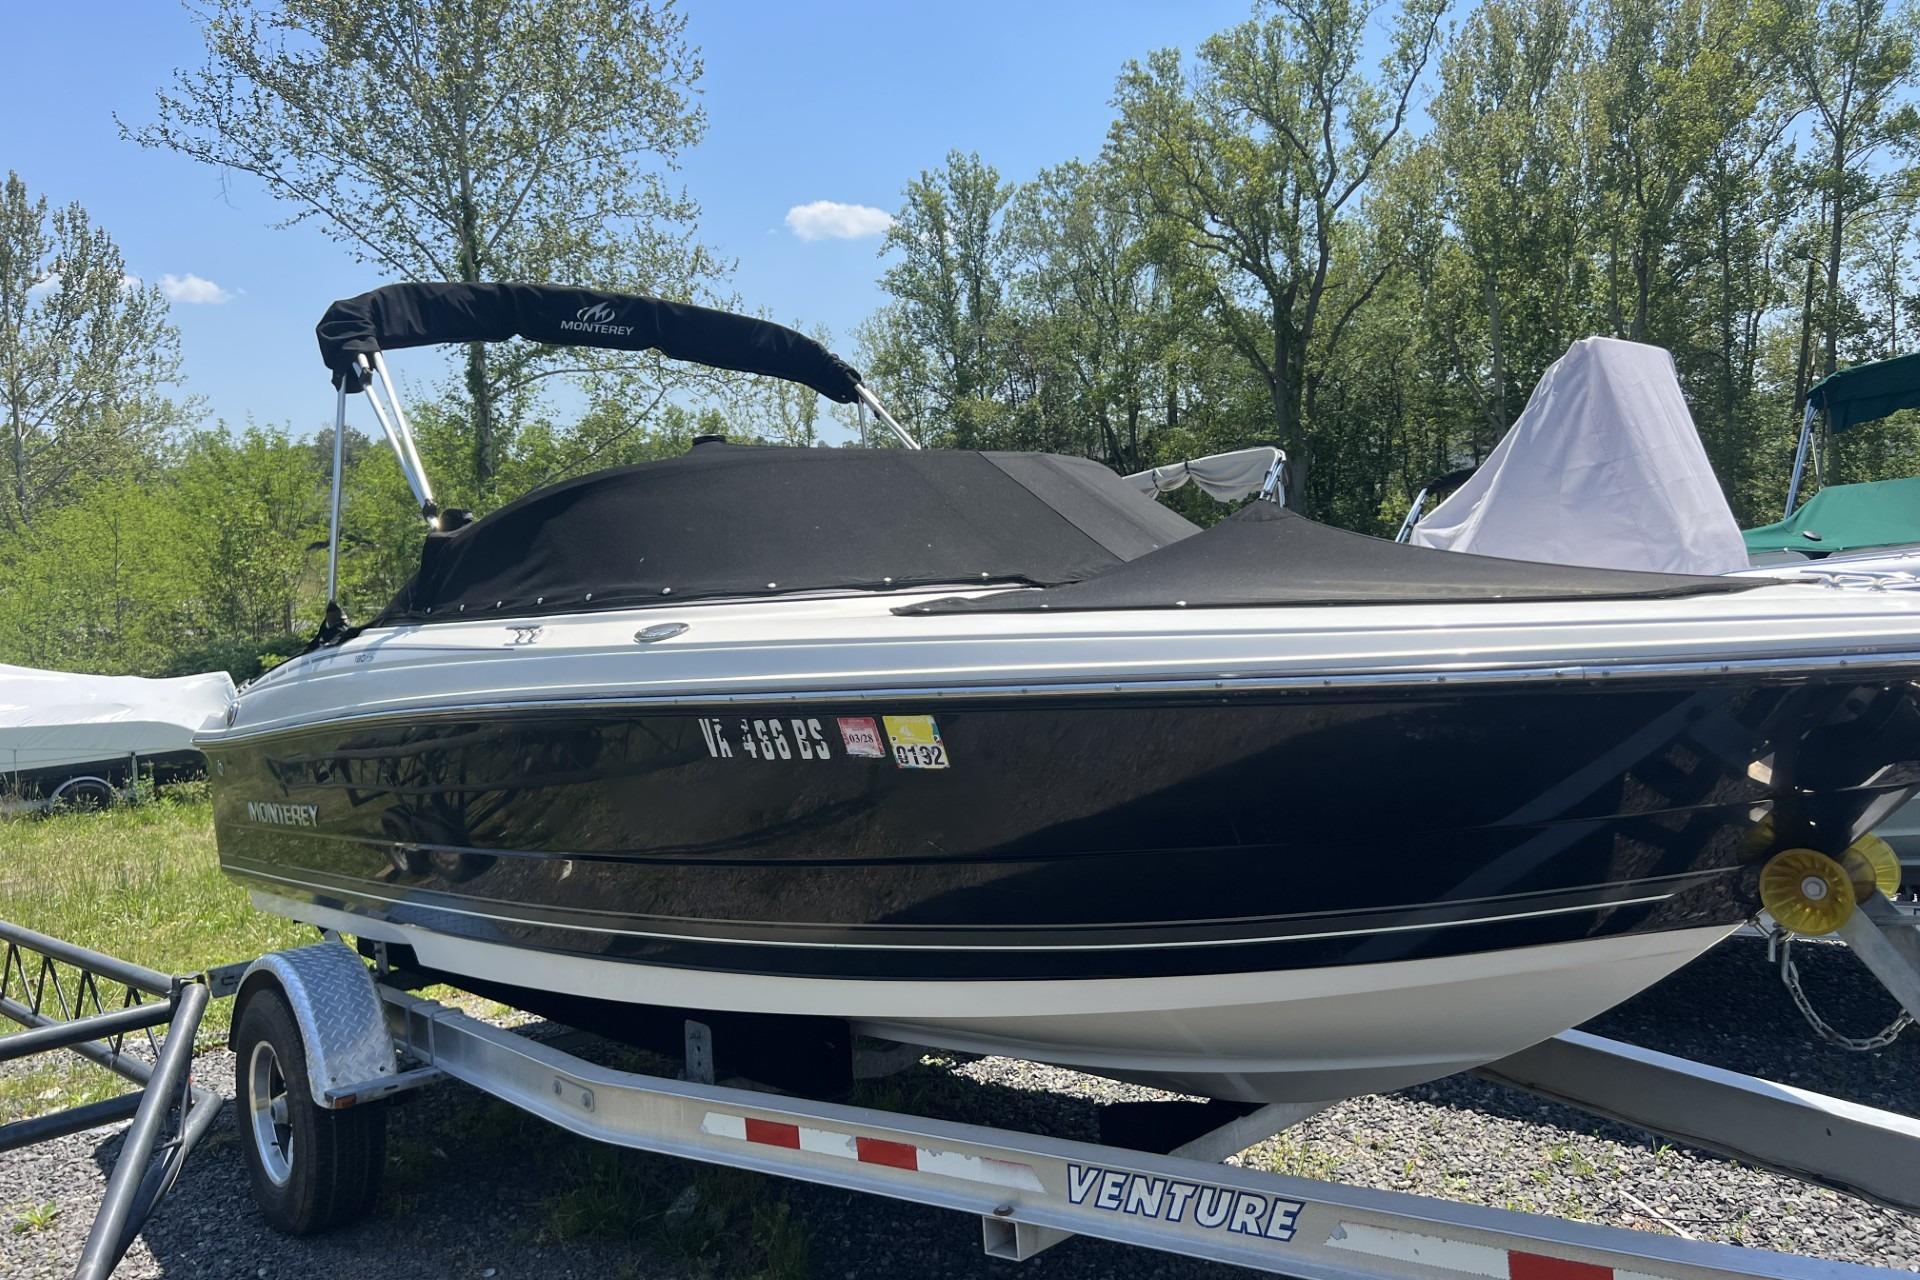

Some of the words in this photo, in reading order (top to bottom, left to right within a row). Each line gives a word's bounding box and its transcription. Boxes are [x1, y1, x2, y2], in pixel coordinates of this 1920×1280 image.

[560, 320, 634, 335] MONTEREY
[791, 718, 831, 760] BS
[848, 733, 874, 744] 03/28
[247, 801, 319, 827] MONTEREY
[1067, 1163, 1306, 1242] VENTURE
